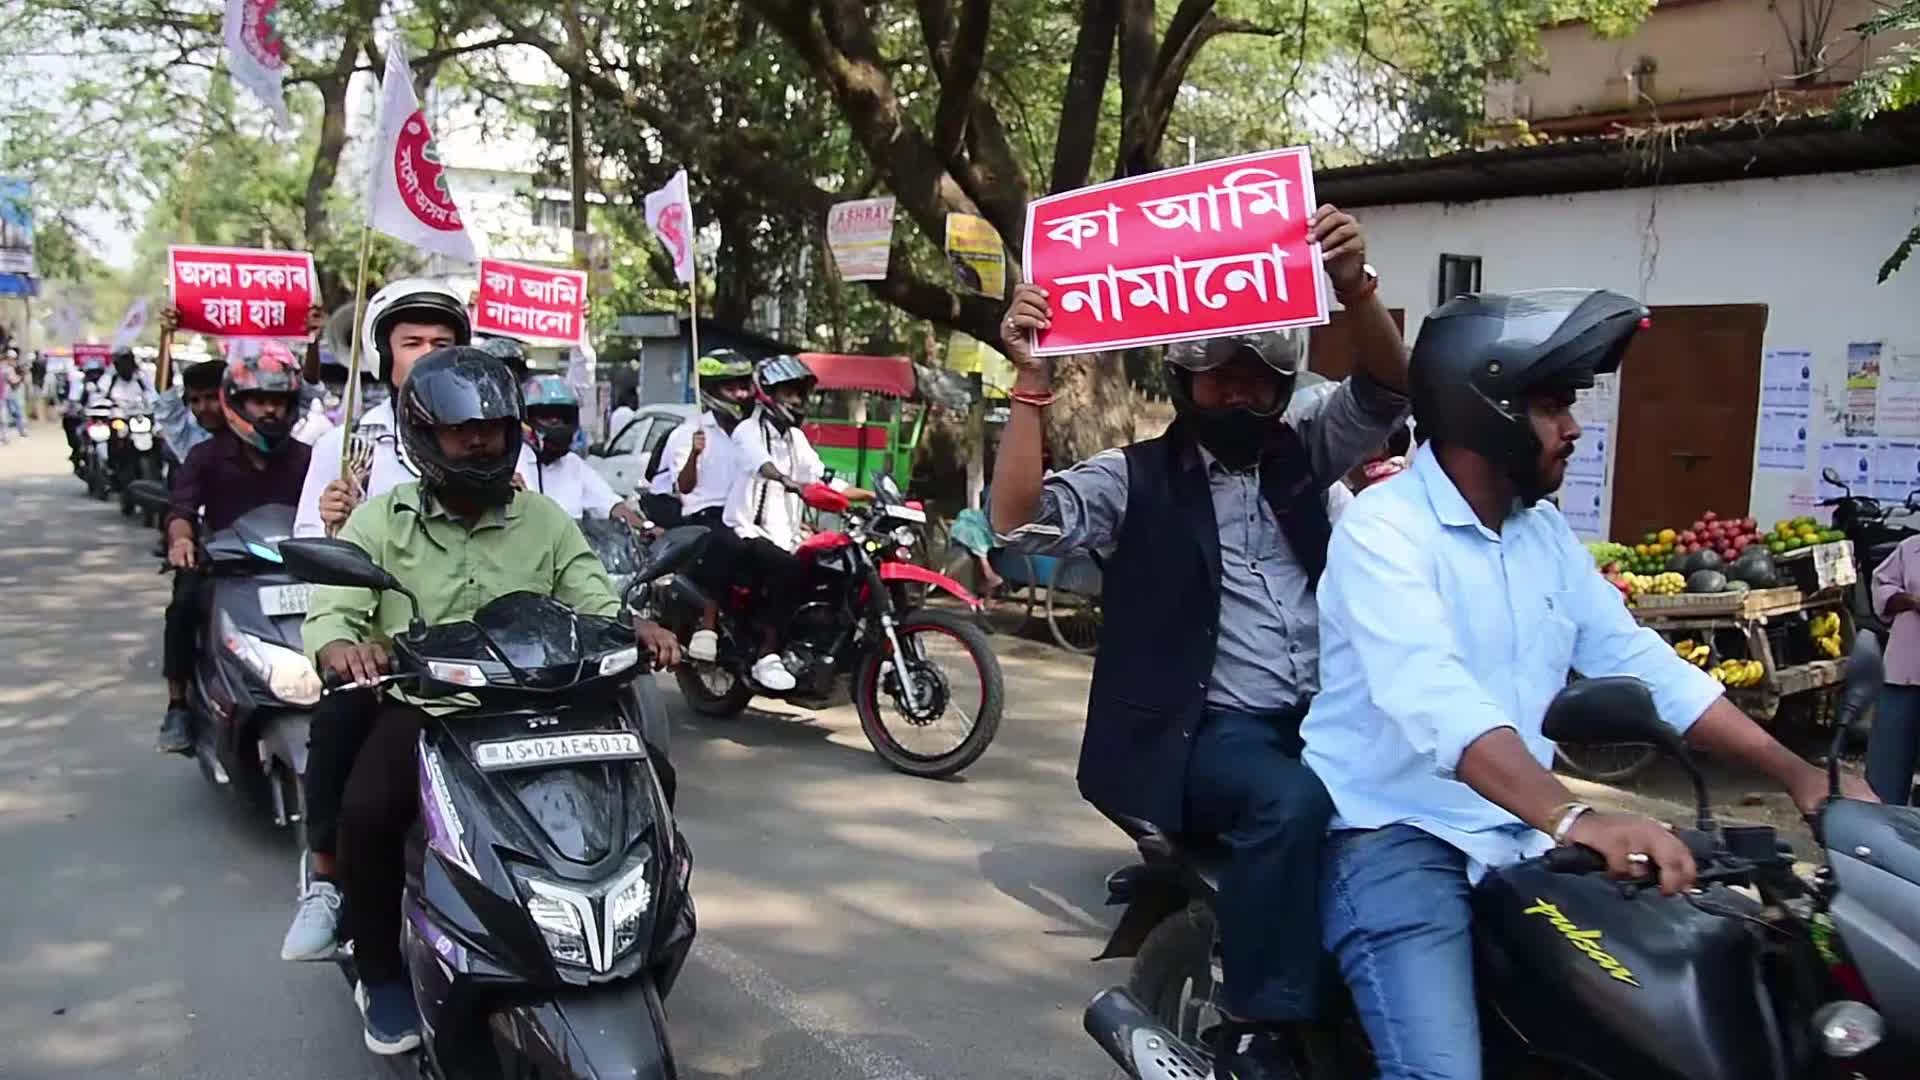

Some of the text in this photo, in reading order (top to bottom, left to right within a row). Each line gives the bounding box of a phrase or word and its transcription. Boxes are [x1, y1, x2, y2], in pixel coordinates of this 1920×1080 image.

[1042, 202, 1125, 250] কা
[1137, 168, 1294, 232] আমি
[176, 261, 232, 288] অসম
[485, 270, 578, 305] কা আমি
[1052, 243, 1290, 322] নামানো
[201, 297, 286, 329] হায় হায়
[485, 300, 573, 336] নামানো
